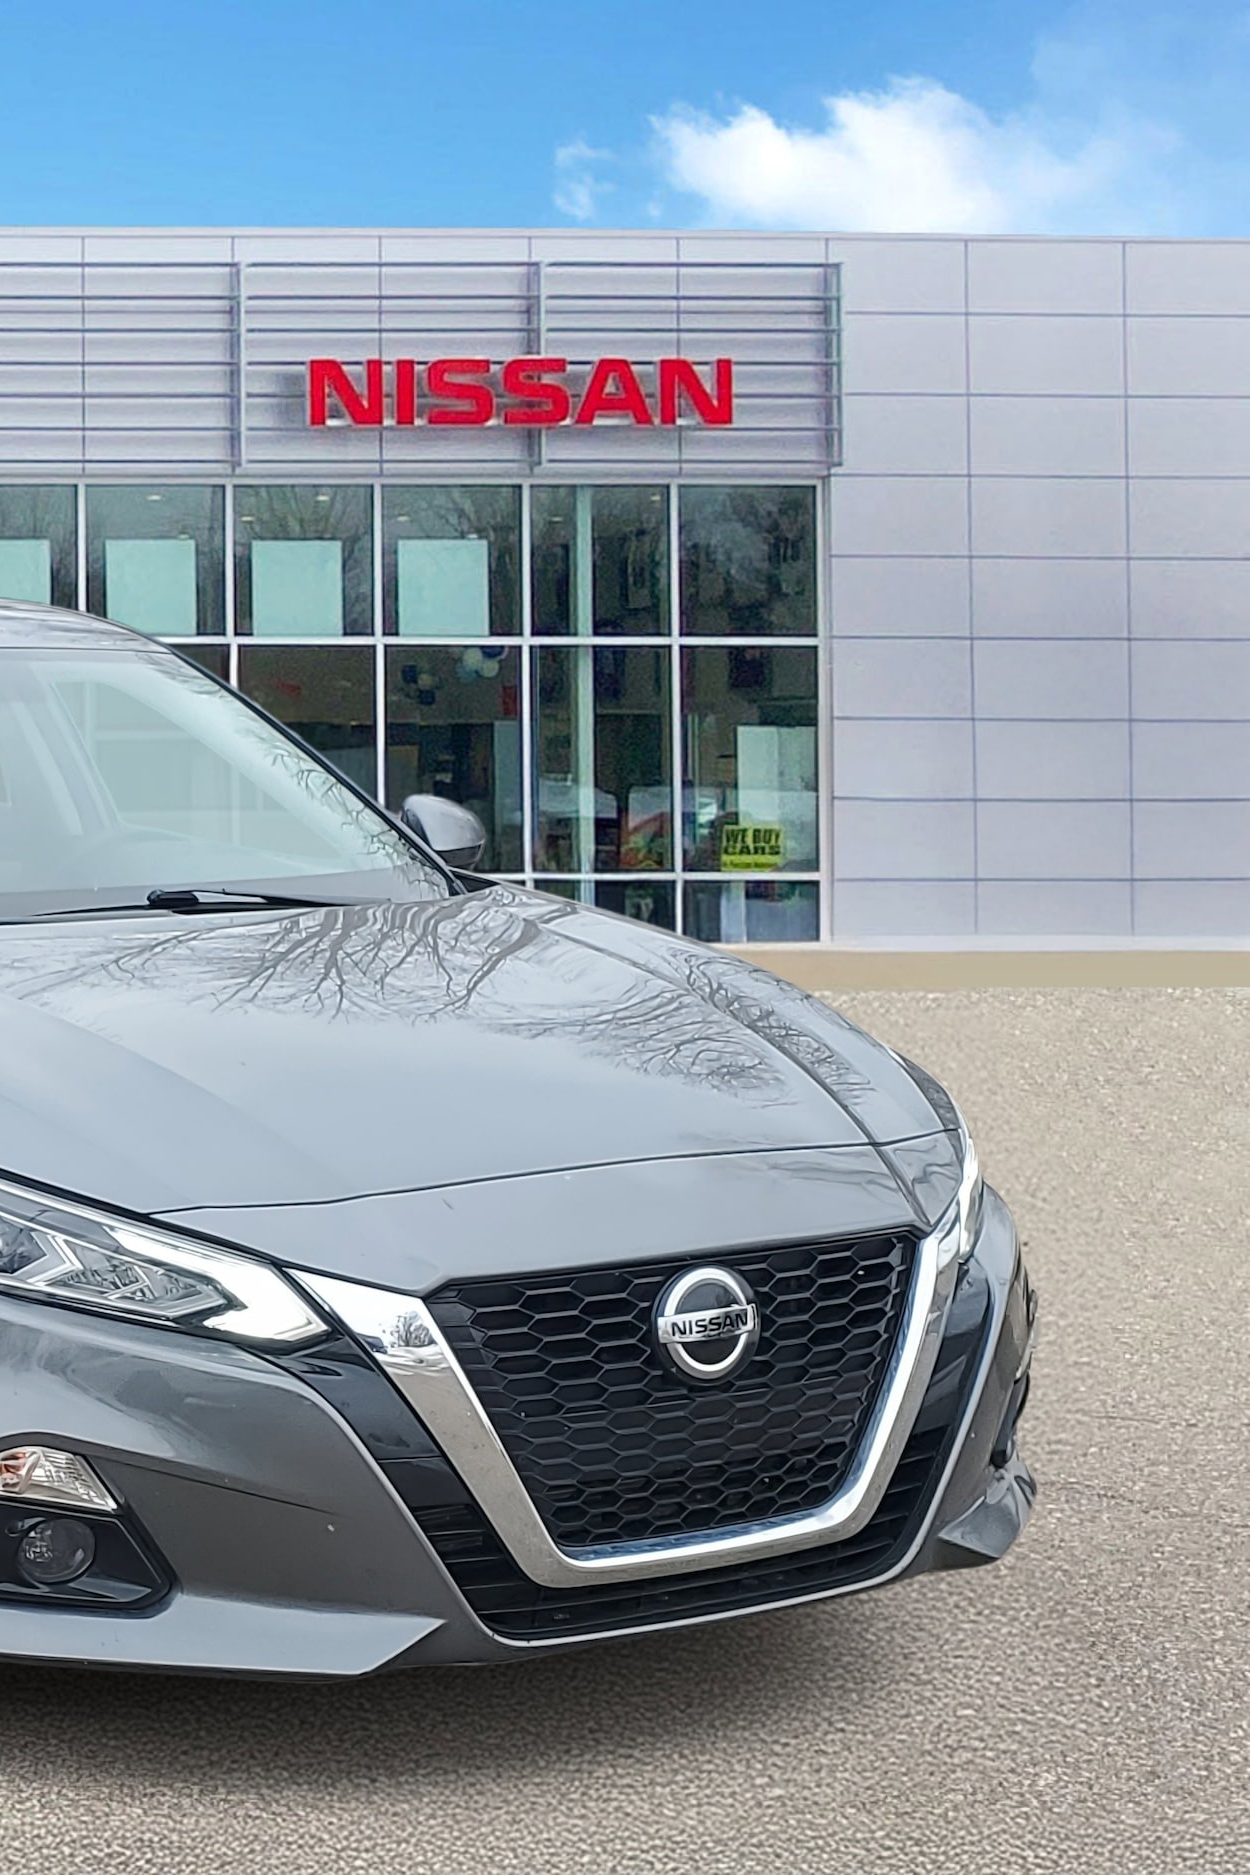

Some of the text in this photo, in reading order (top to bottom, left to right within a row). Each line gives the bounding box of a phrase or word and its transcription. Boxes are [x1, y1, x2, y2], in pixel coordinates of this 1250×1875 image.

[308, 358, 734, 426] NISSAN
[724, 828, 782, 844] WE BUY
[723, 844, 782, 856] CARS
[671, 1310, 748, 1337] NISSAN
